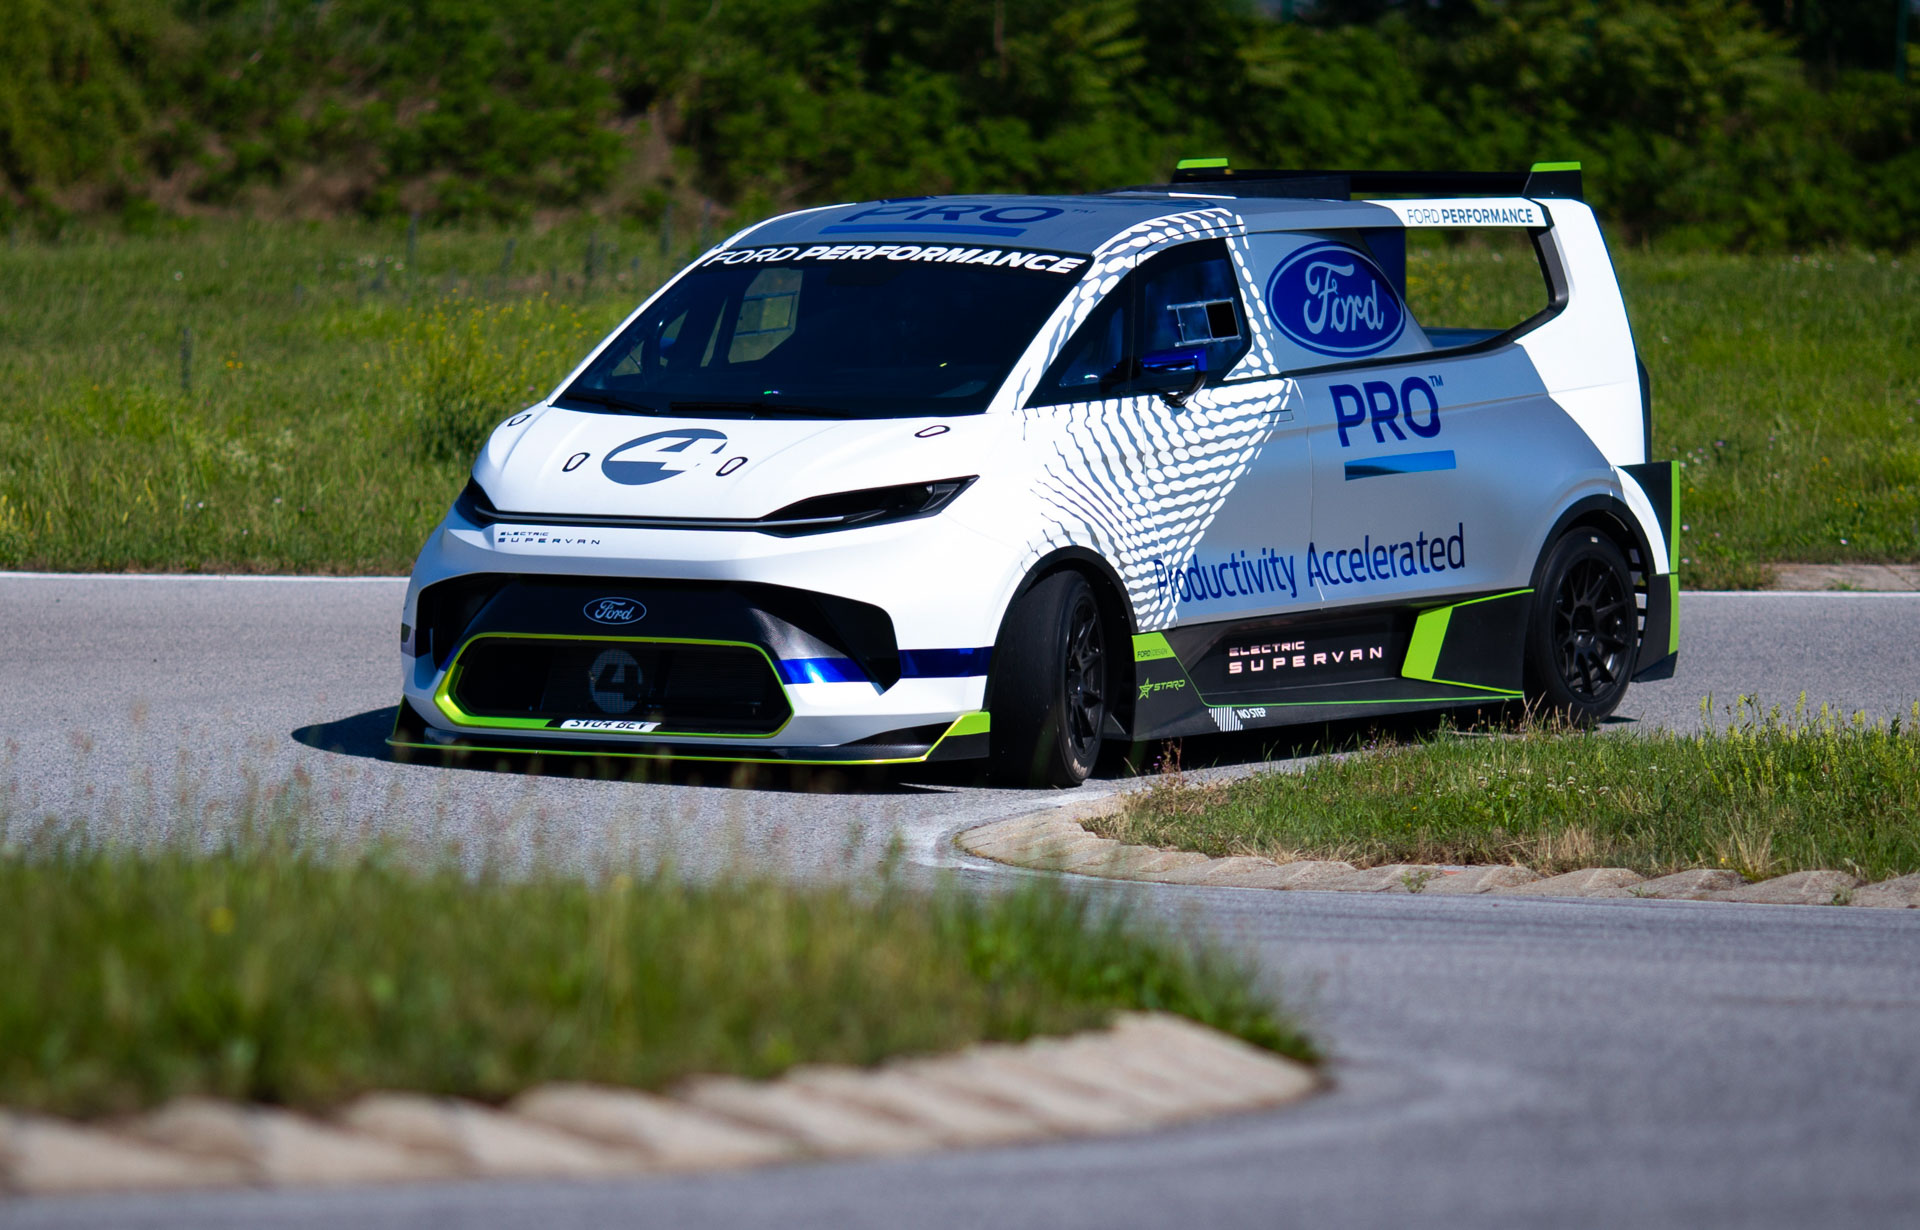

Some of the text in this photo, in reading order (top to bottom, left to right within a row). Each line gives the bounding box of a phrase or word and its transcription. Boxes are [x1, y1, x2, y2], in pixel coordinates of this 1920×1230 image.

[840, 204, 1065, 224] PRO
[1406, 208, 1534, 224] FORD PERFORMANCE
[702, 245, 1086, 275] FORD PERFORMANCE
[1303, 261, 1385, 335] Ford
[1328, 376, 1441, 448] PRO
[497, 537, 601, 545] SUPERVAN
[1153, 522, 1466, 605] Productivity Accelerated
[594, 600, 635, 620] Ford
[1228, 640, 1305, 657] ELECTRIC
[1228, 646, 1384, 675] SUPERVAN
[1236, 706, 1267, 719] NO STEP
